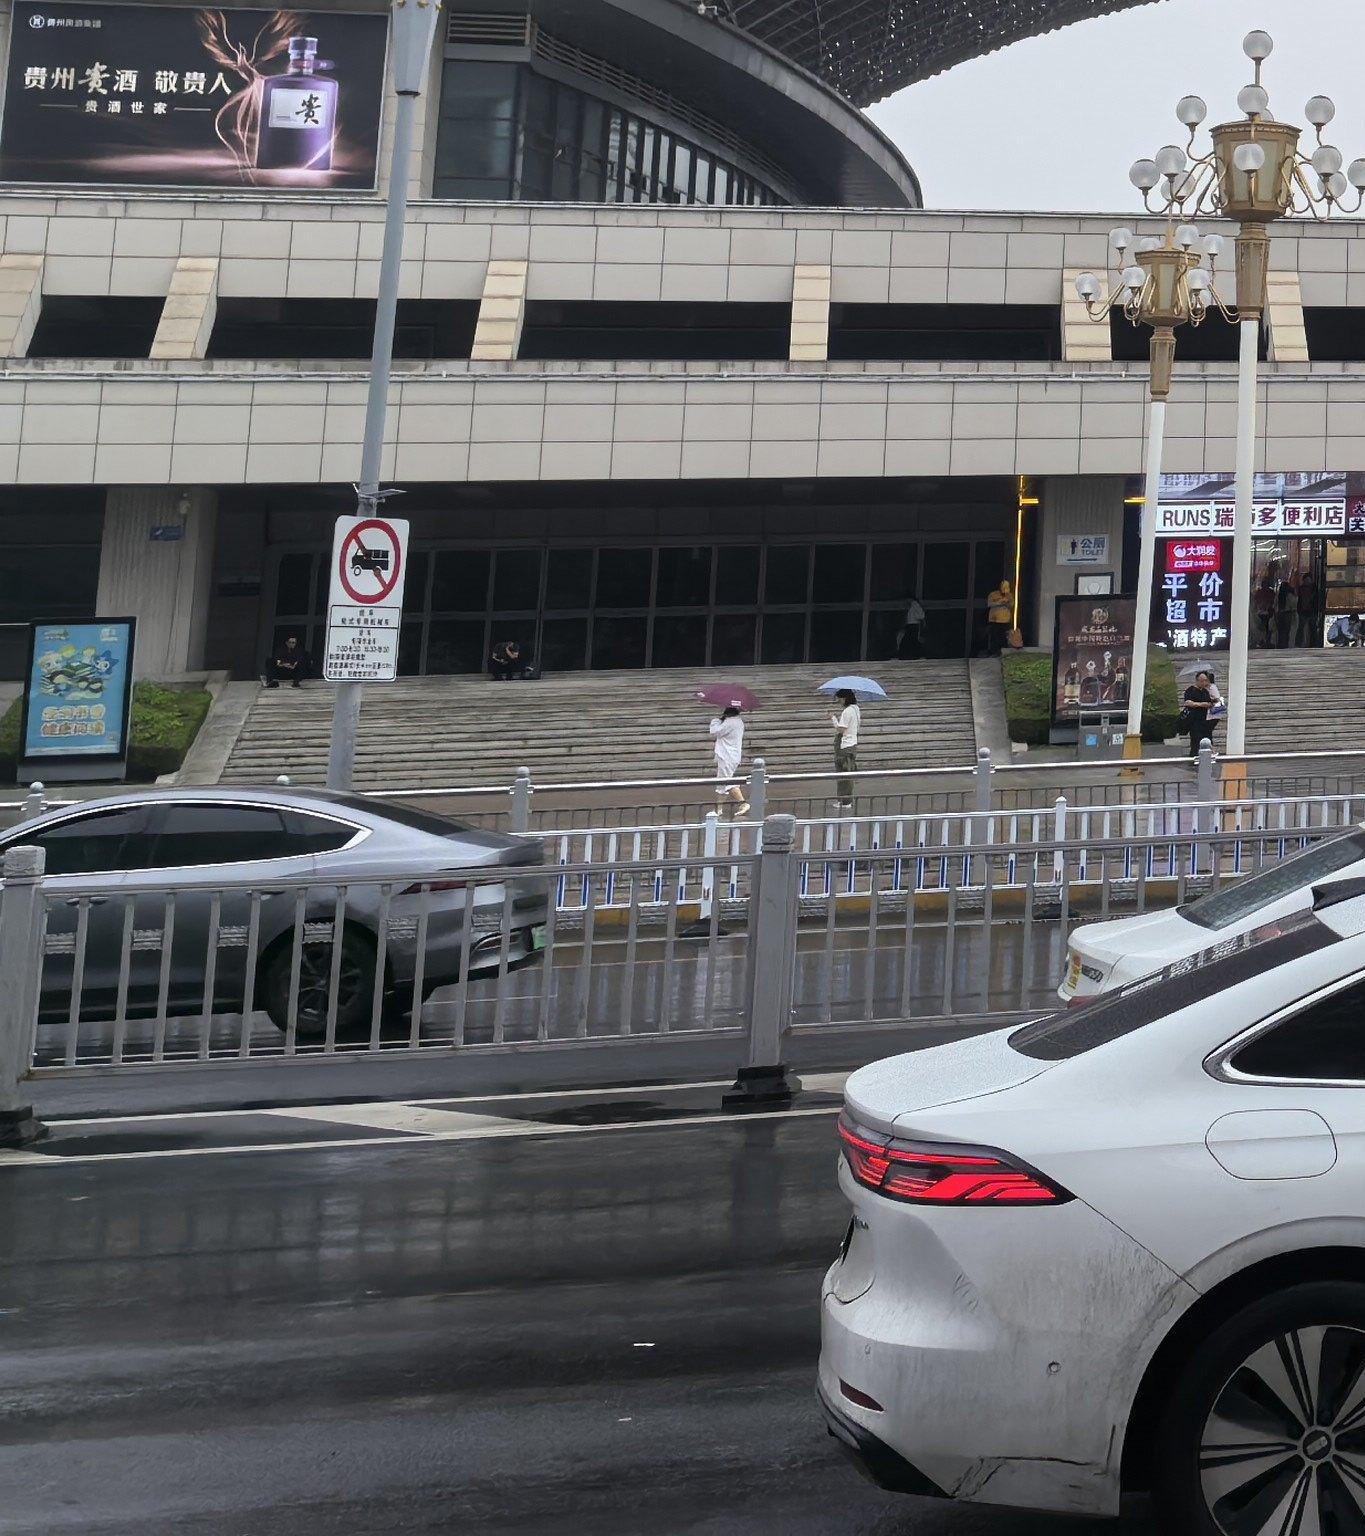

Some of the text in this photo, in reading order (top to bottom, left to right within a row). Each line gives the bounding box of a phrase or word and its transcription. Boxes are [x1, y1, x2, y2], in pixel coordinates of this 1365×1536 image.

[155, 70, 232, 95] 敬贵人
[84, 99, 168, 115] 贵酒世家
[1163, 509, 1211, 527] RUNS
[1080, 538, 1106, 549] 公厕
[1162, 572, 1224, 598] 平价
[1166, 598, 1223, 624] 超市
[1156, 626, 1228, 648] 酒特产
